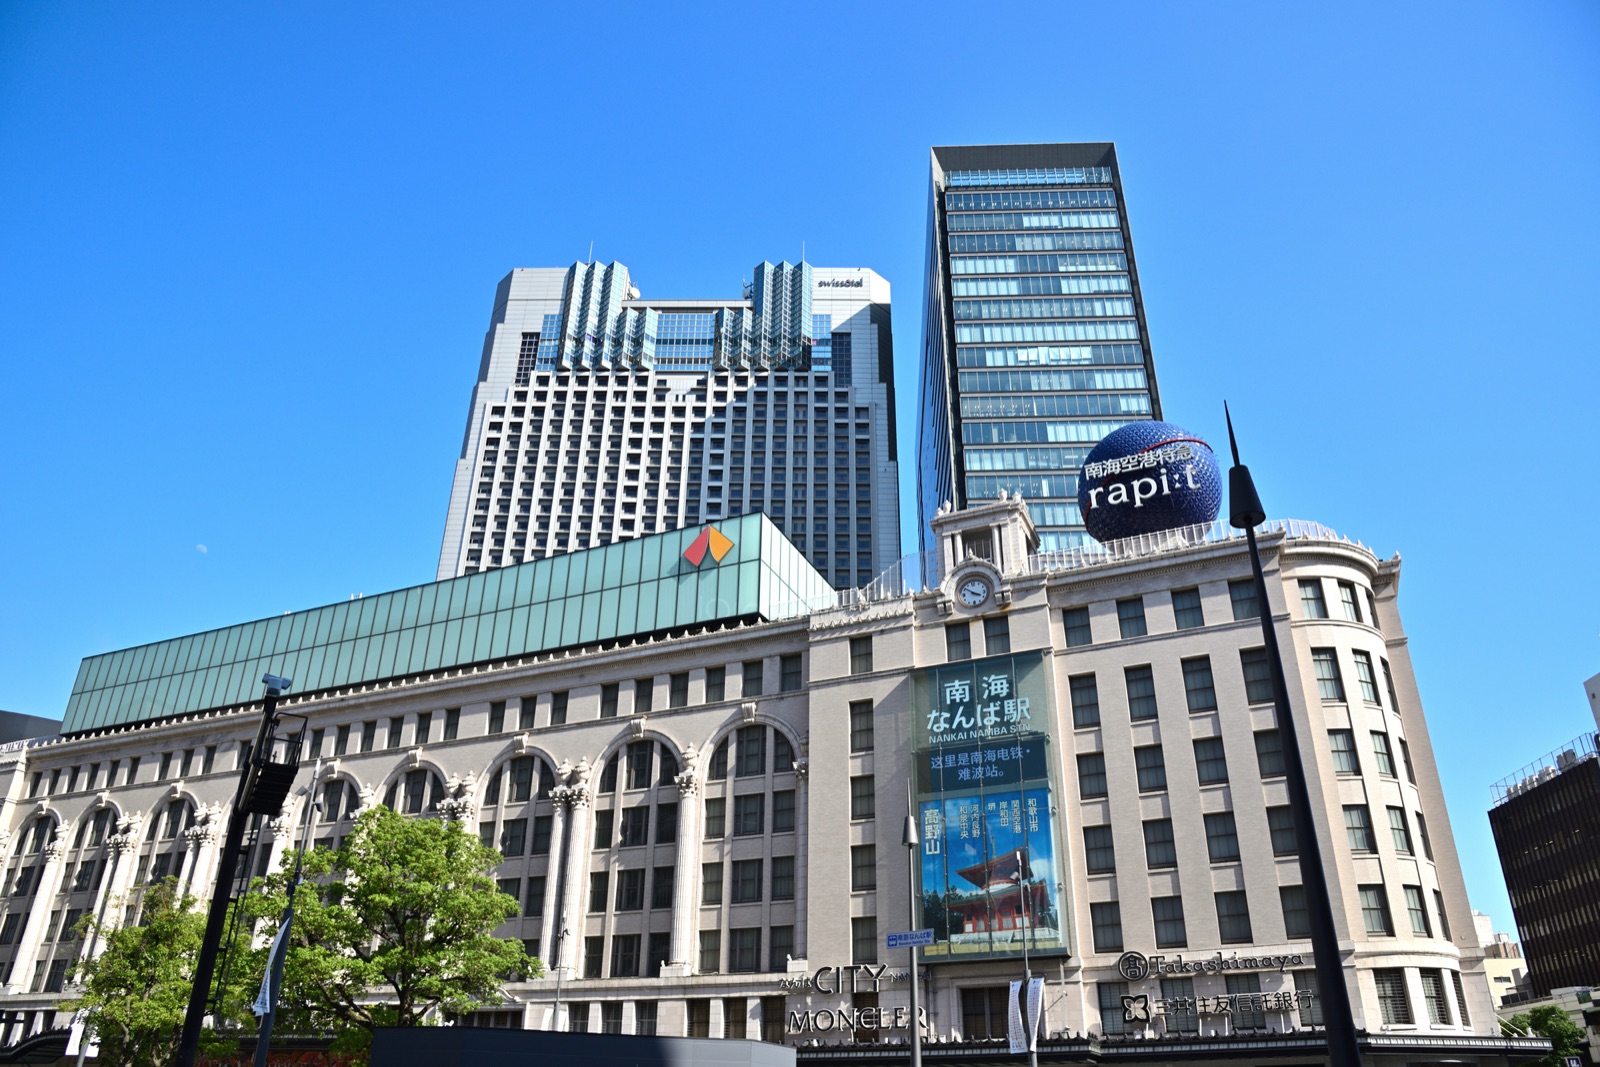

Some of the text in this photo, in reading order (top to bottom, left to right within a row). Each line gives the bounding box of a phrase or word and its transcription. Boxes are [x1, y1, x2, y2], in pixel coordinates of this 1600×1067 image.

[1084, 444, 1194, 480] 南海空港特急
[927, 697, 1031, 733] なんば駅
[929, 723, 1031, 744] NANKAI NAMBA STN
[999, 801, 1009, 827] 岸和田
[1028, 798, 1039, 832] 和歌山市
[924, 809, 940, 855] 高野山
[1150, 952, 1304, 973] Takashimaya
[814, 963, 888, 994] CITY
[1153, 989, 1314, 1016] 三井住友信託銀行
[788, 1006, 929, 1033] MONCLER
